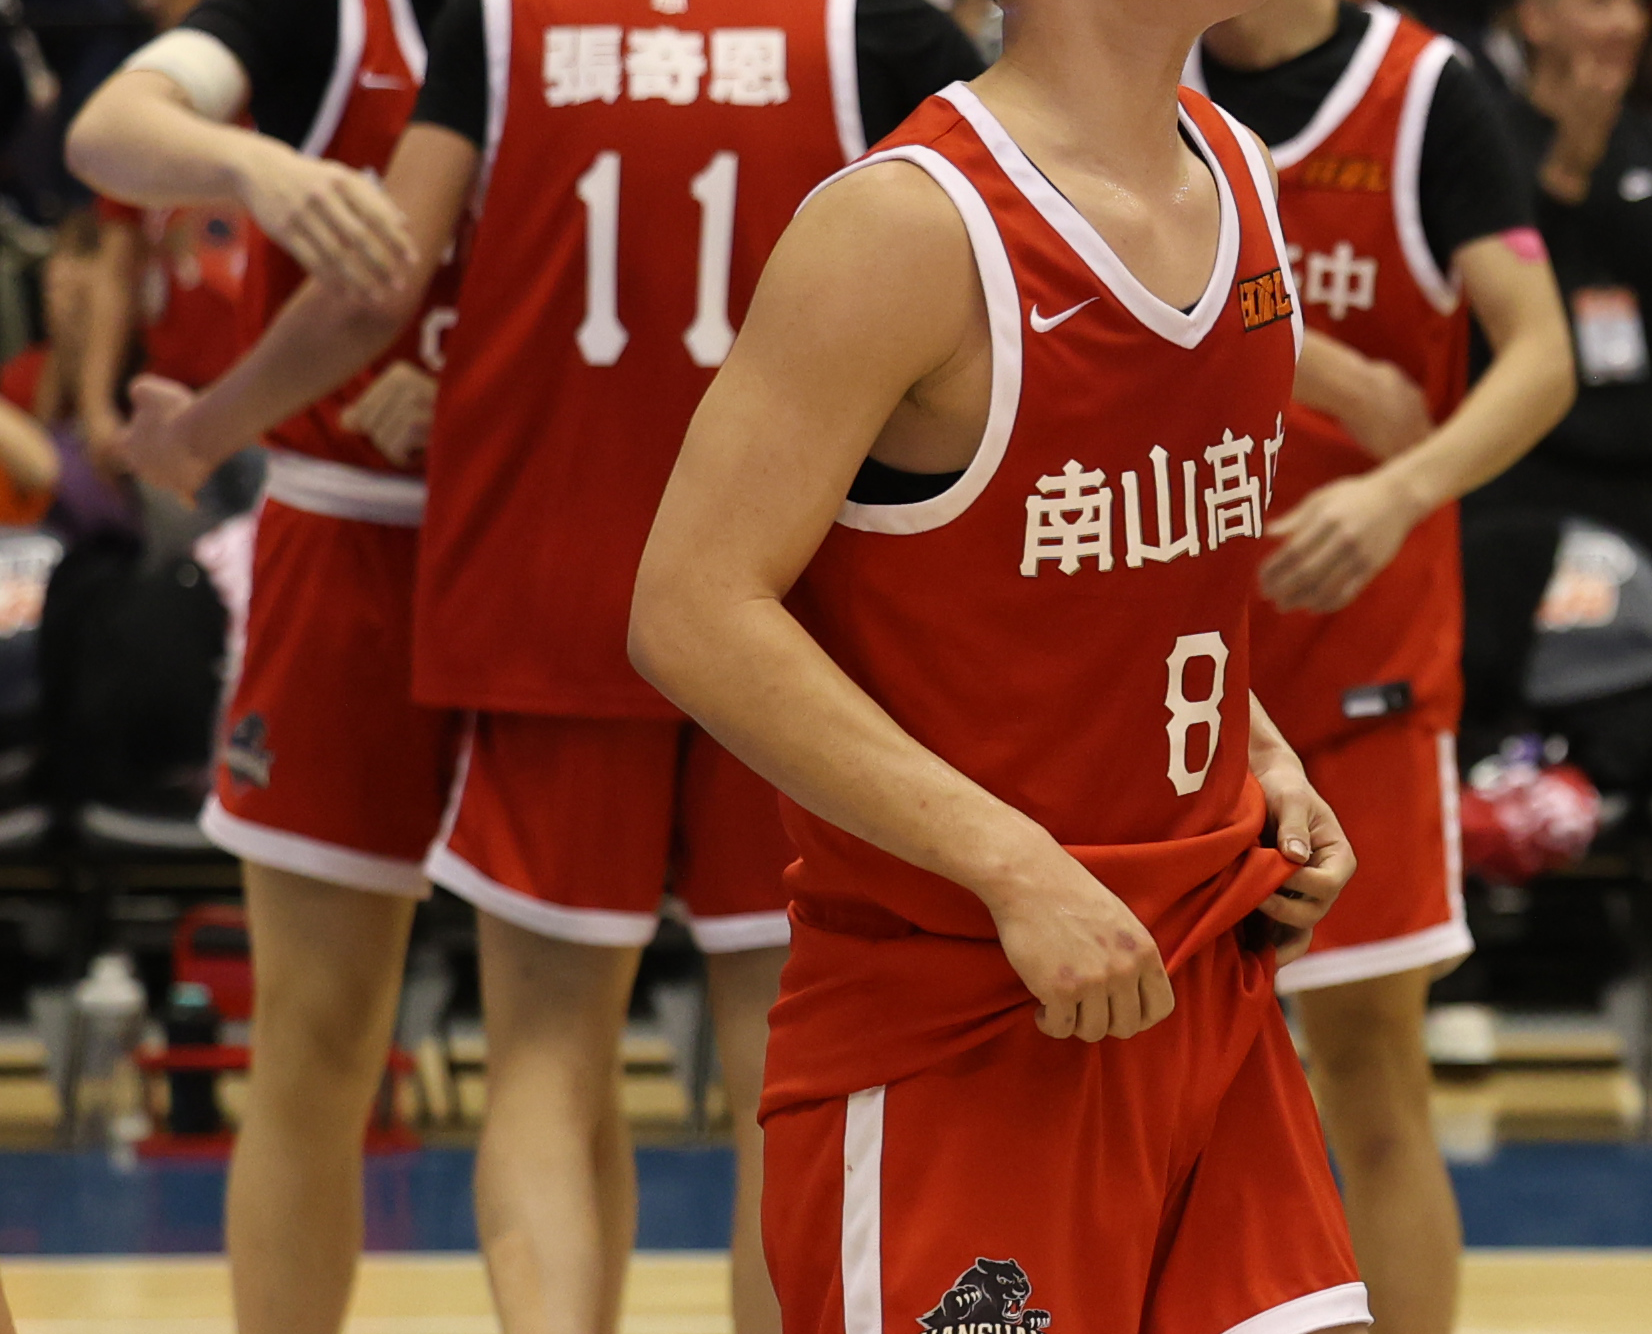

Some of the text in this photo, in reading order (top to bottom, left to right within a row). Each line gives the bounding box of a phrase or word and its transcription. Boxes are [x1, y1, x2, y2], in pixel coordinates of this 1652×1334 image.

[543, 24, 791, 108] 張奇恩
[574, 148, 739, 368] 11
[1164, 631, 1229, 796] 8
